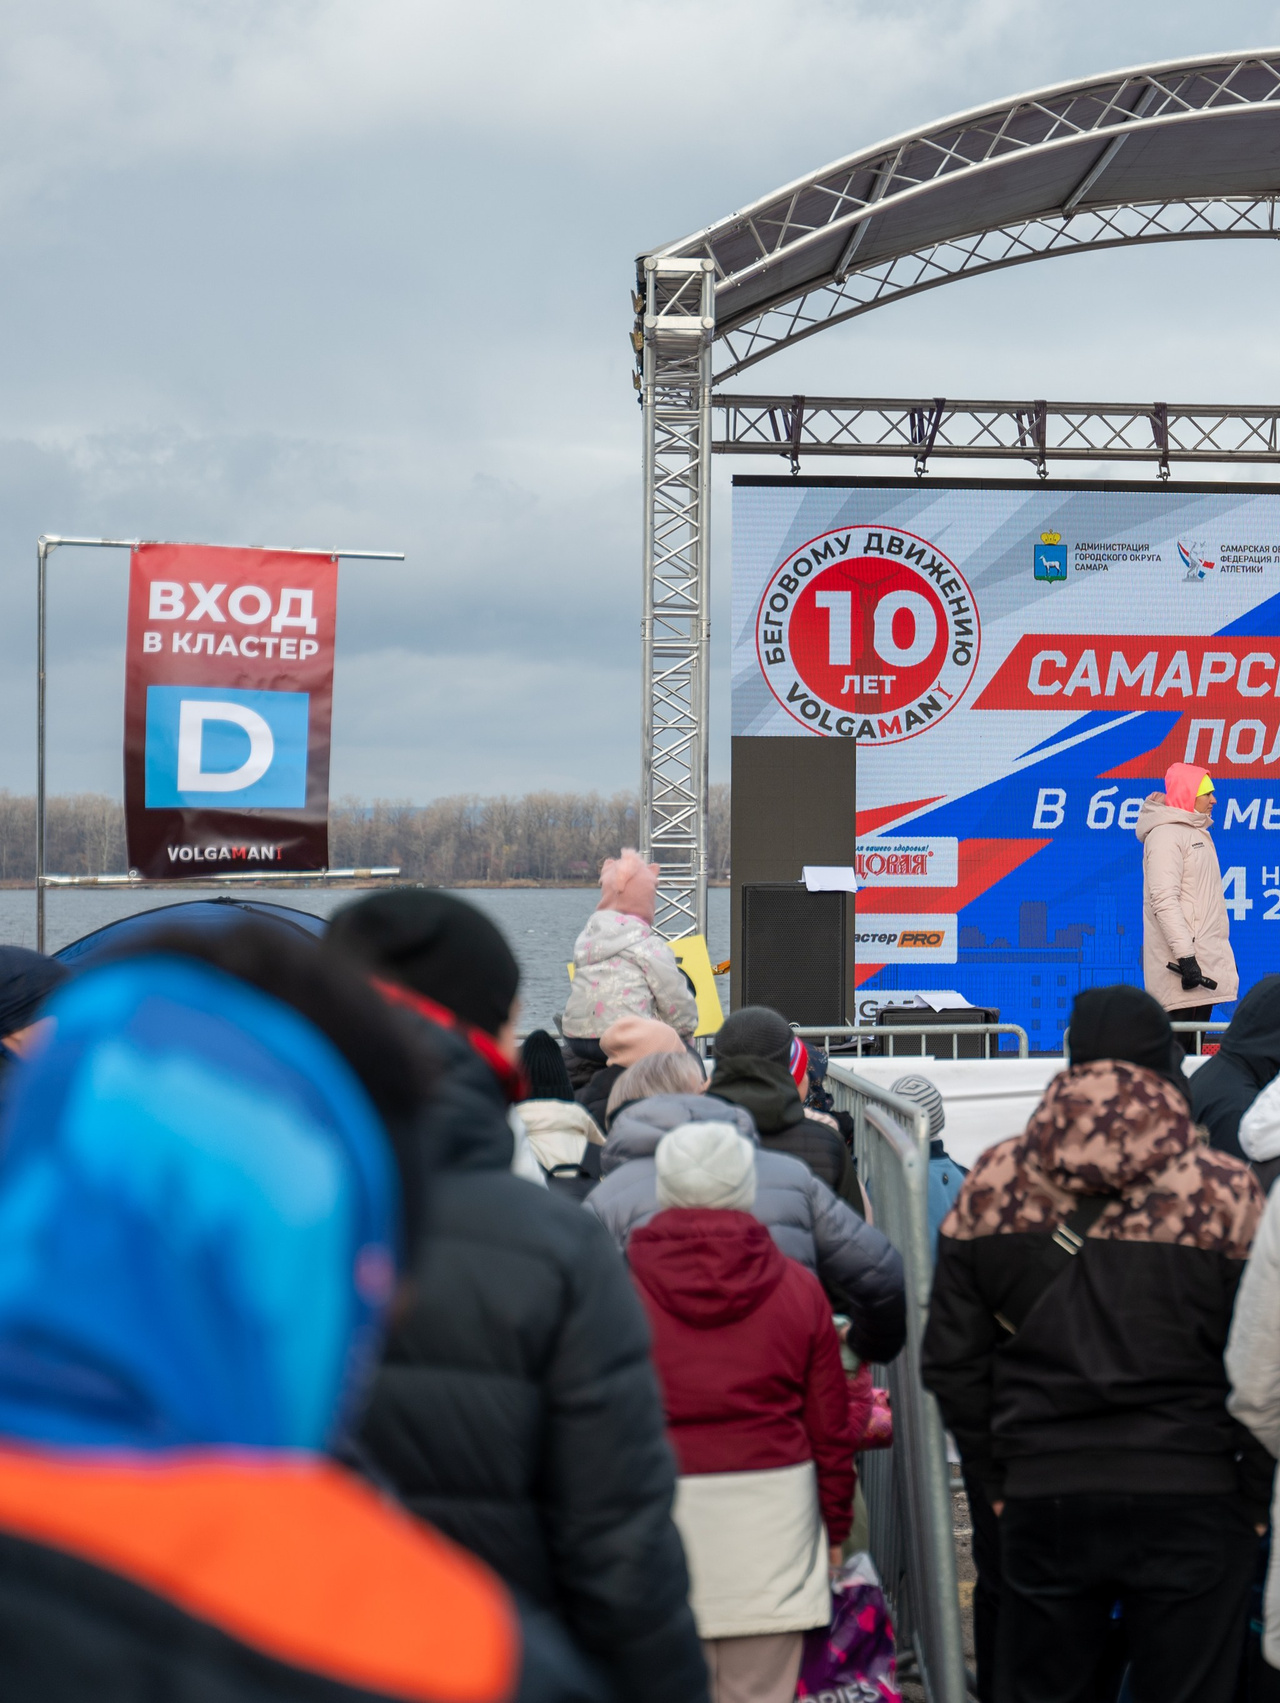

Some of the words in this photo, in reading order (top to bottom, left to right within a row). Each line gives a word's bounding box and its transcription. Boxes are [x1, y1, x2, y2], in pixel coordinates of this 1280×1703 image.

[1074, 543, 1150, 552] АДМИНИСТРАЦИЯ
[1220, 544, 1270, 554] САМАРСКАЯ
[1074, 553, 1128, 562] ГОРОДСКОГО
[1129, 554, 1162, 562] ОКРУГА
[1220, 555, 1272, 564] ФЕДЕРАЦИЯ
[1074, 563, 1109, 572] САМАРА
[1220, 565, 1263, 573] АТЛЕТИКИ
[764, 534, 852, 666] БЕГОВОМУ
[863, 532, 973, 667] ДВИЖЕНИЮ
[148, 581, 318, 635] ВХОД
[815, 589, 938, 668] 10
[143, 631, 162, 653] В
[172, 633, 319, 660] КЛАСТЕР
[841, 675, 897, 695] ЛЕТ
[177, 700, 274, 792] D
[1032, 787, 1067, 830] В
[1086, 785, 1142, 830] бе
[894, 844, 929, 853] здоровья!
[855, 933, 898, 945] астер
[900, 933, 941, 945] PRO
